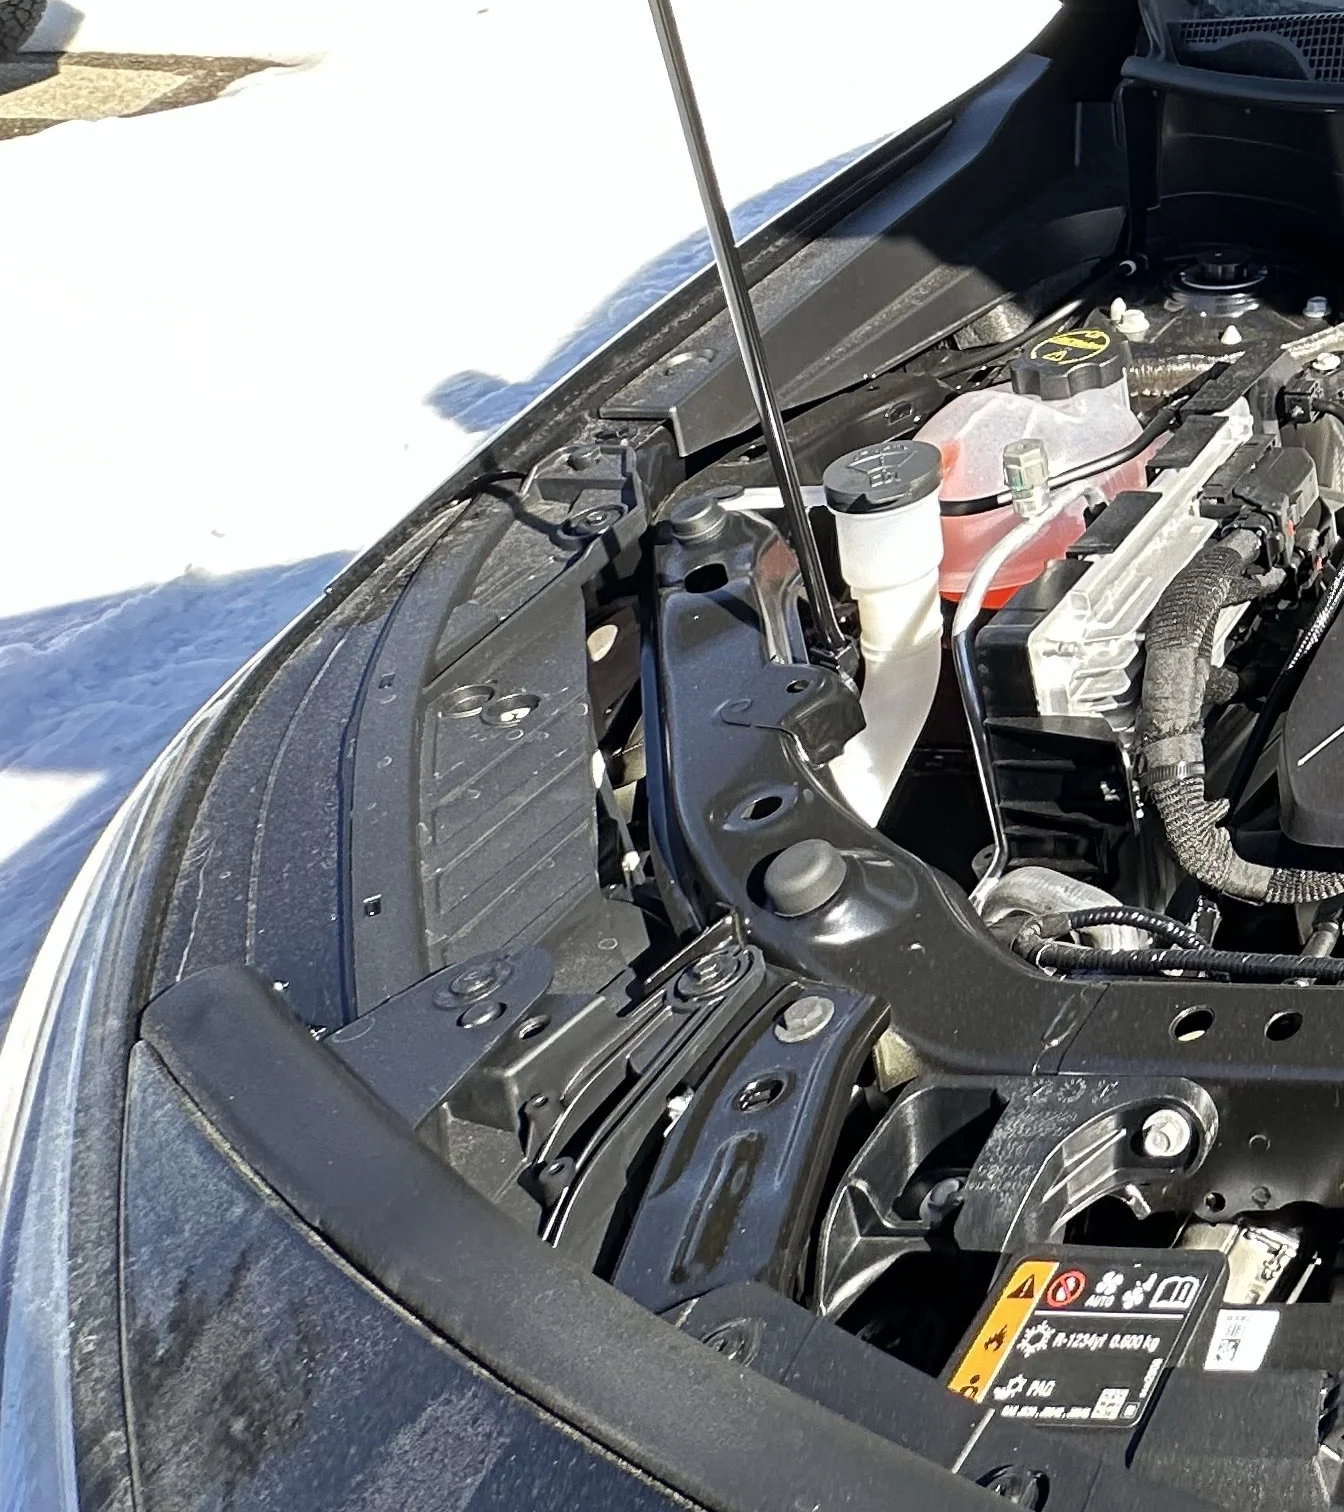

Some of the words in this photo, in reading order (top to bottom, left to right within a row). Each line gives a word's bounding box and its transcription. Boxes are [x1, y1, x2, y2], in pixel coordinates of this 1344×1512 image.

[1084, 1294, 1115, 1308] AUTO
[1052, 1332, 1107, 1351] R-1234yf
[1108, 1334, 1144, 1350] 0.600
[1142, 1334, 1161, 1353] kg
